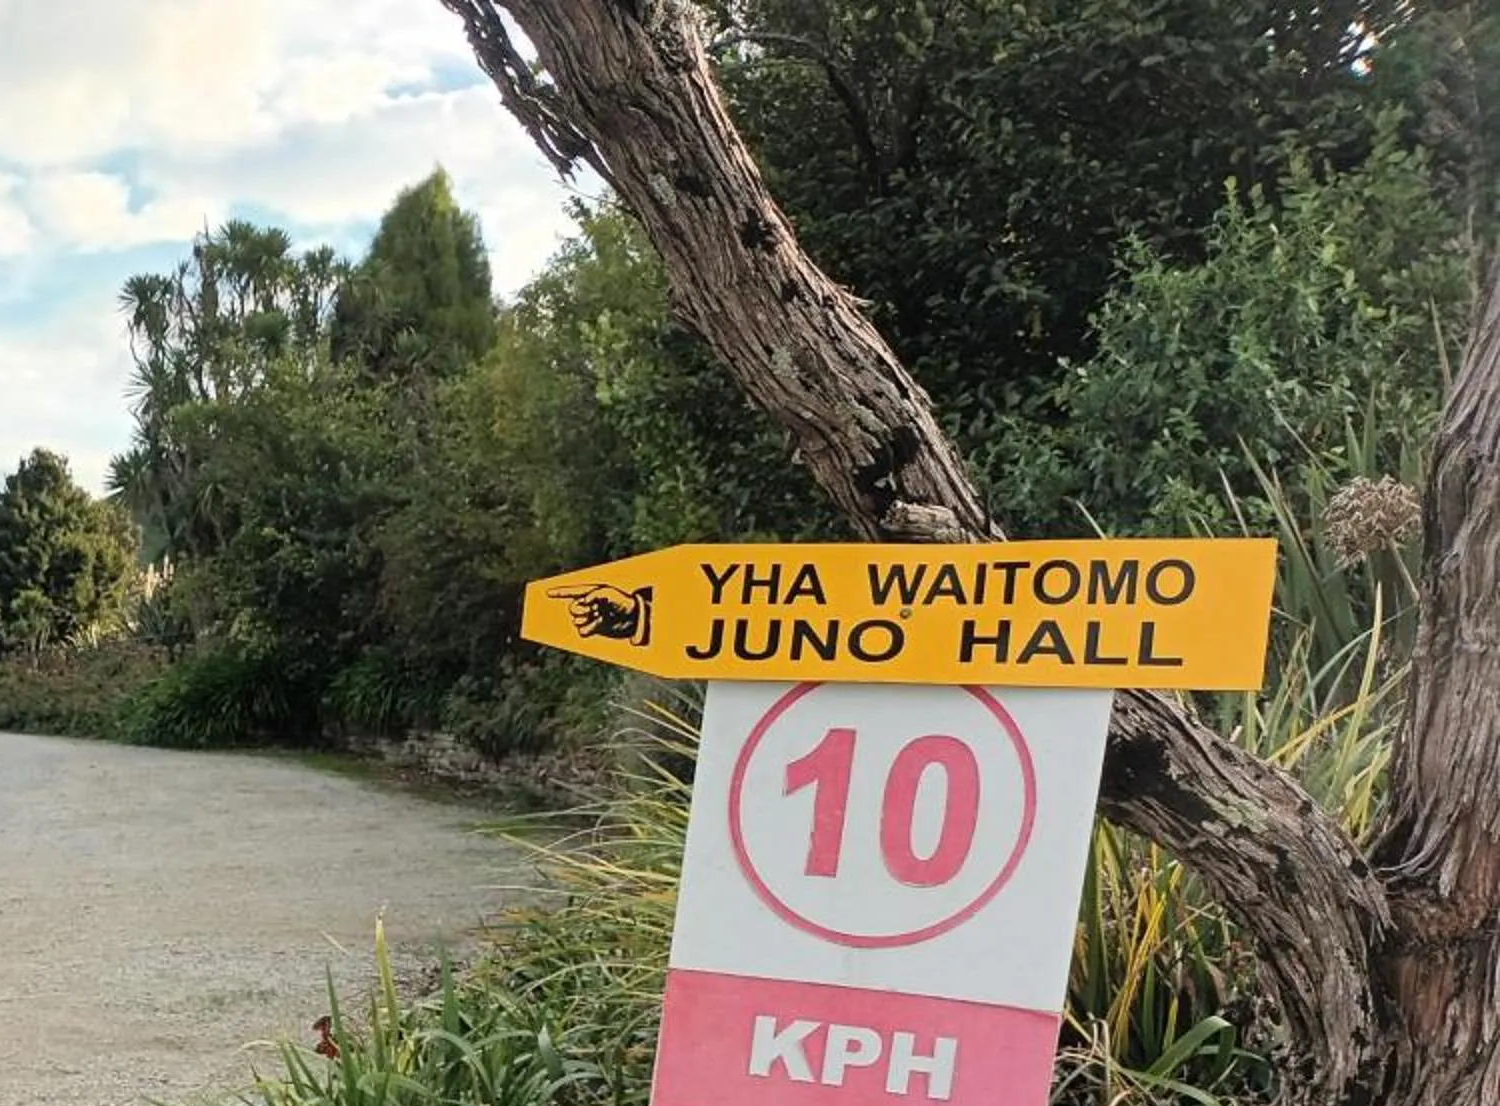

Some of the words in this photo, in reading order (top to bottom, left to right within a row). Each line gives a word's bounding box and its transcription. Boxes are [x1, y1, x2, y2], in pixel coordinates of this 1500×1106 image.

[700, 563, 827, 605] YHA
[867, 559, 1196, 606] WAITOMO
[685, 618, 906, 662] JUNO
[959, 619, 1183, 667] HALL
[784, 727, 981, 887] 10
[747, 1015, 959, 1101] KPH
